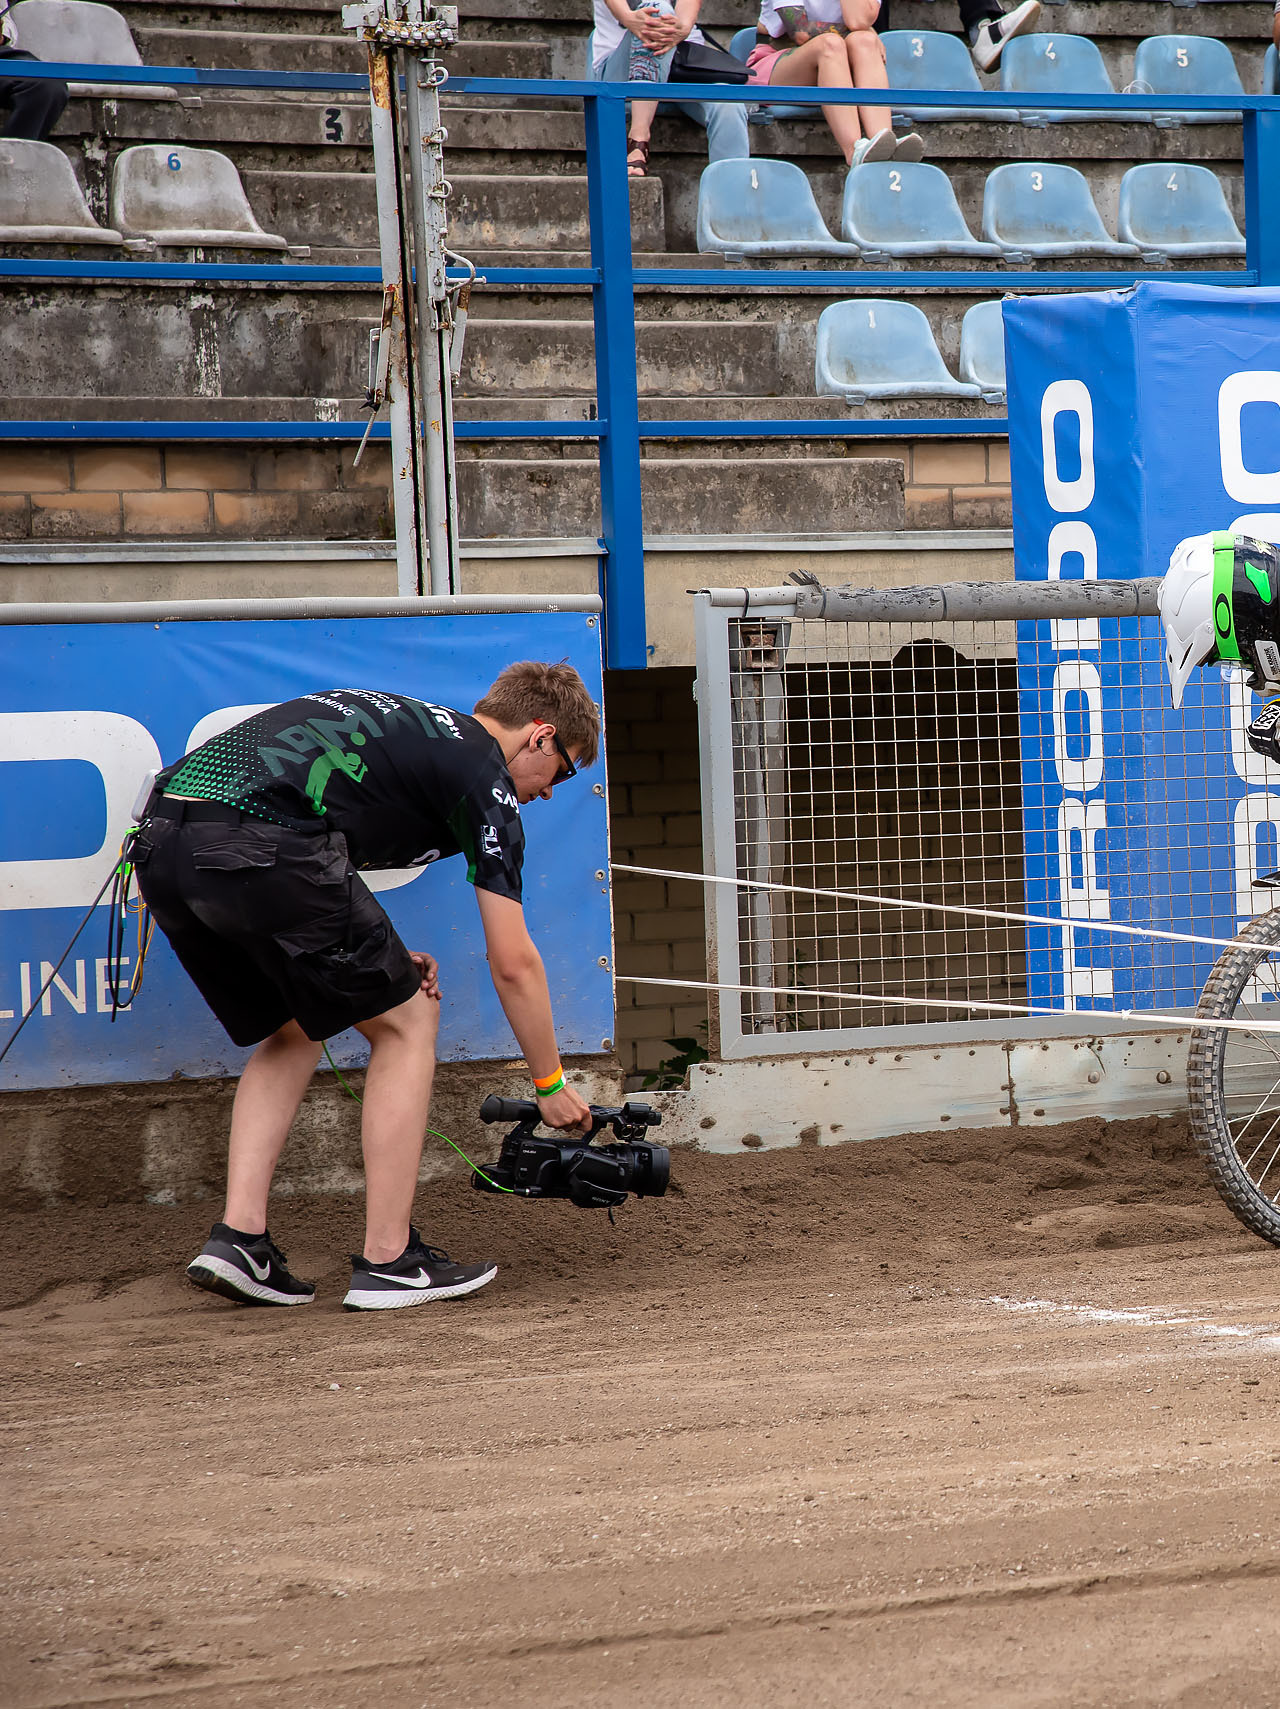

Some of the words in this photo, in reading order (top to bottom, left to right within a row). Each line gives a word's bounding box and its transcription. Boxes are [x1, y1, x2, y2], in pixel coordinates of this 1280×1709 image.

[911, 38, 923, 57] 3
[1045, 42, 1056, 60] 4
[1176, 48, 1189, 67] 5
[325, 108, 343, 142] 3
[167, 153, 181, 171] 6
[889, 170, 902, 192] 2
[1031, 172, 1043, 191] 3
[1167, 172, 1178, 191] 4
